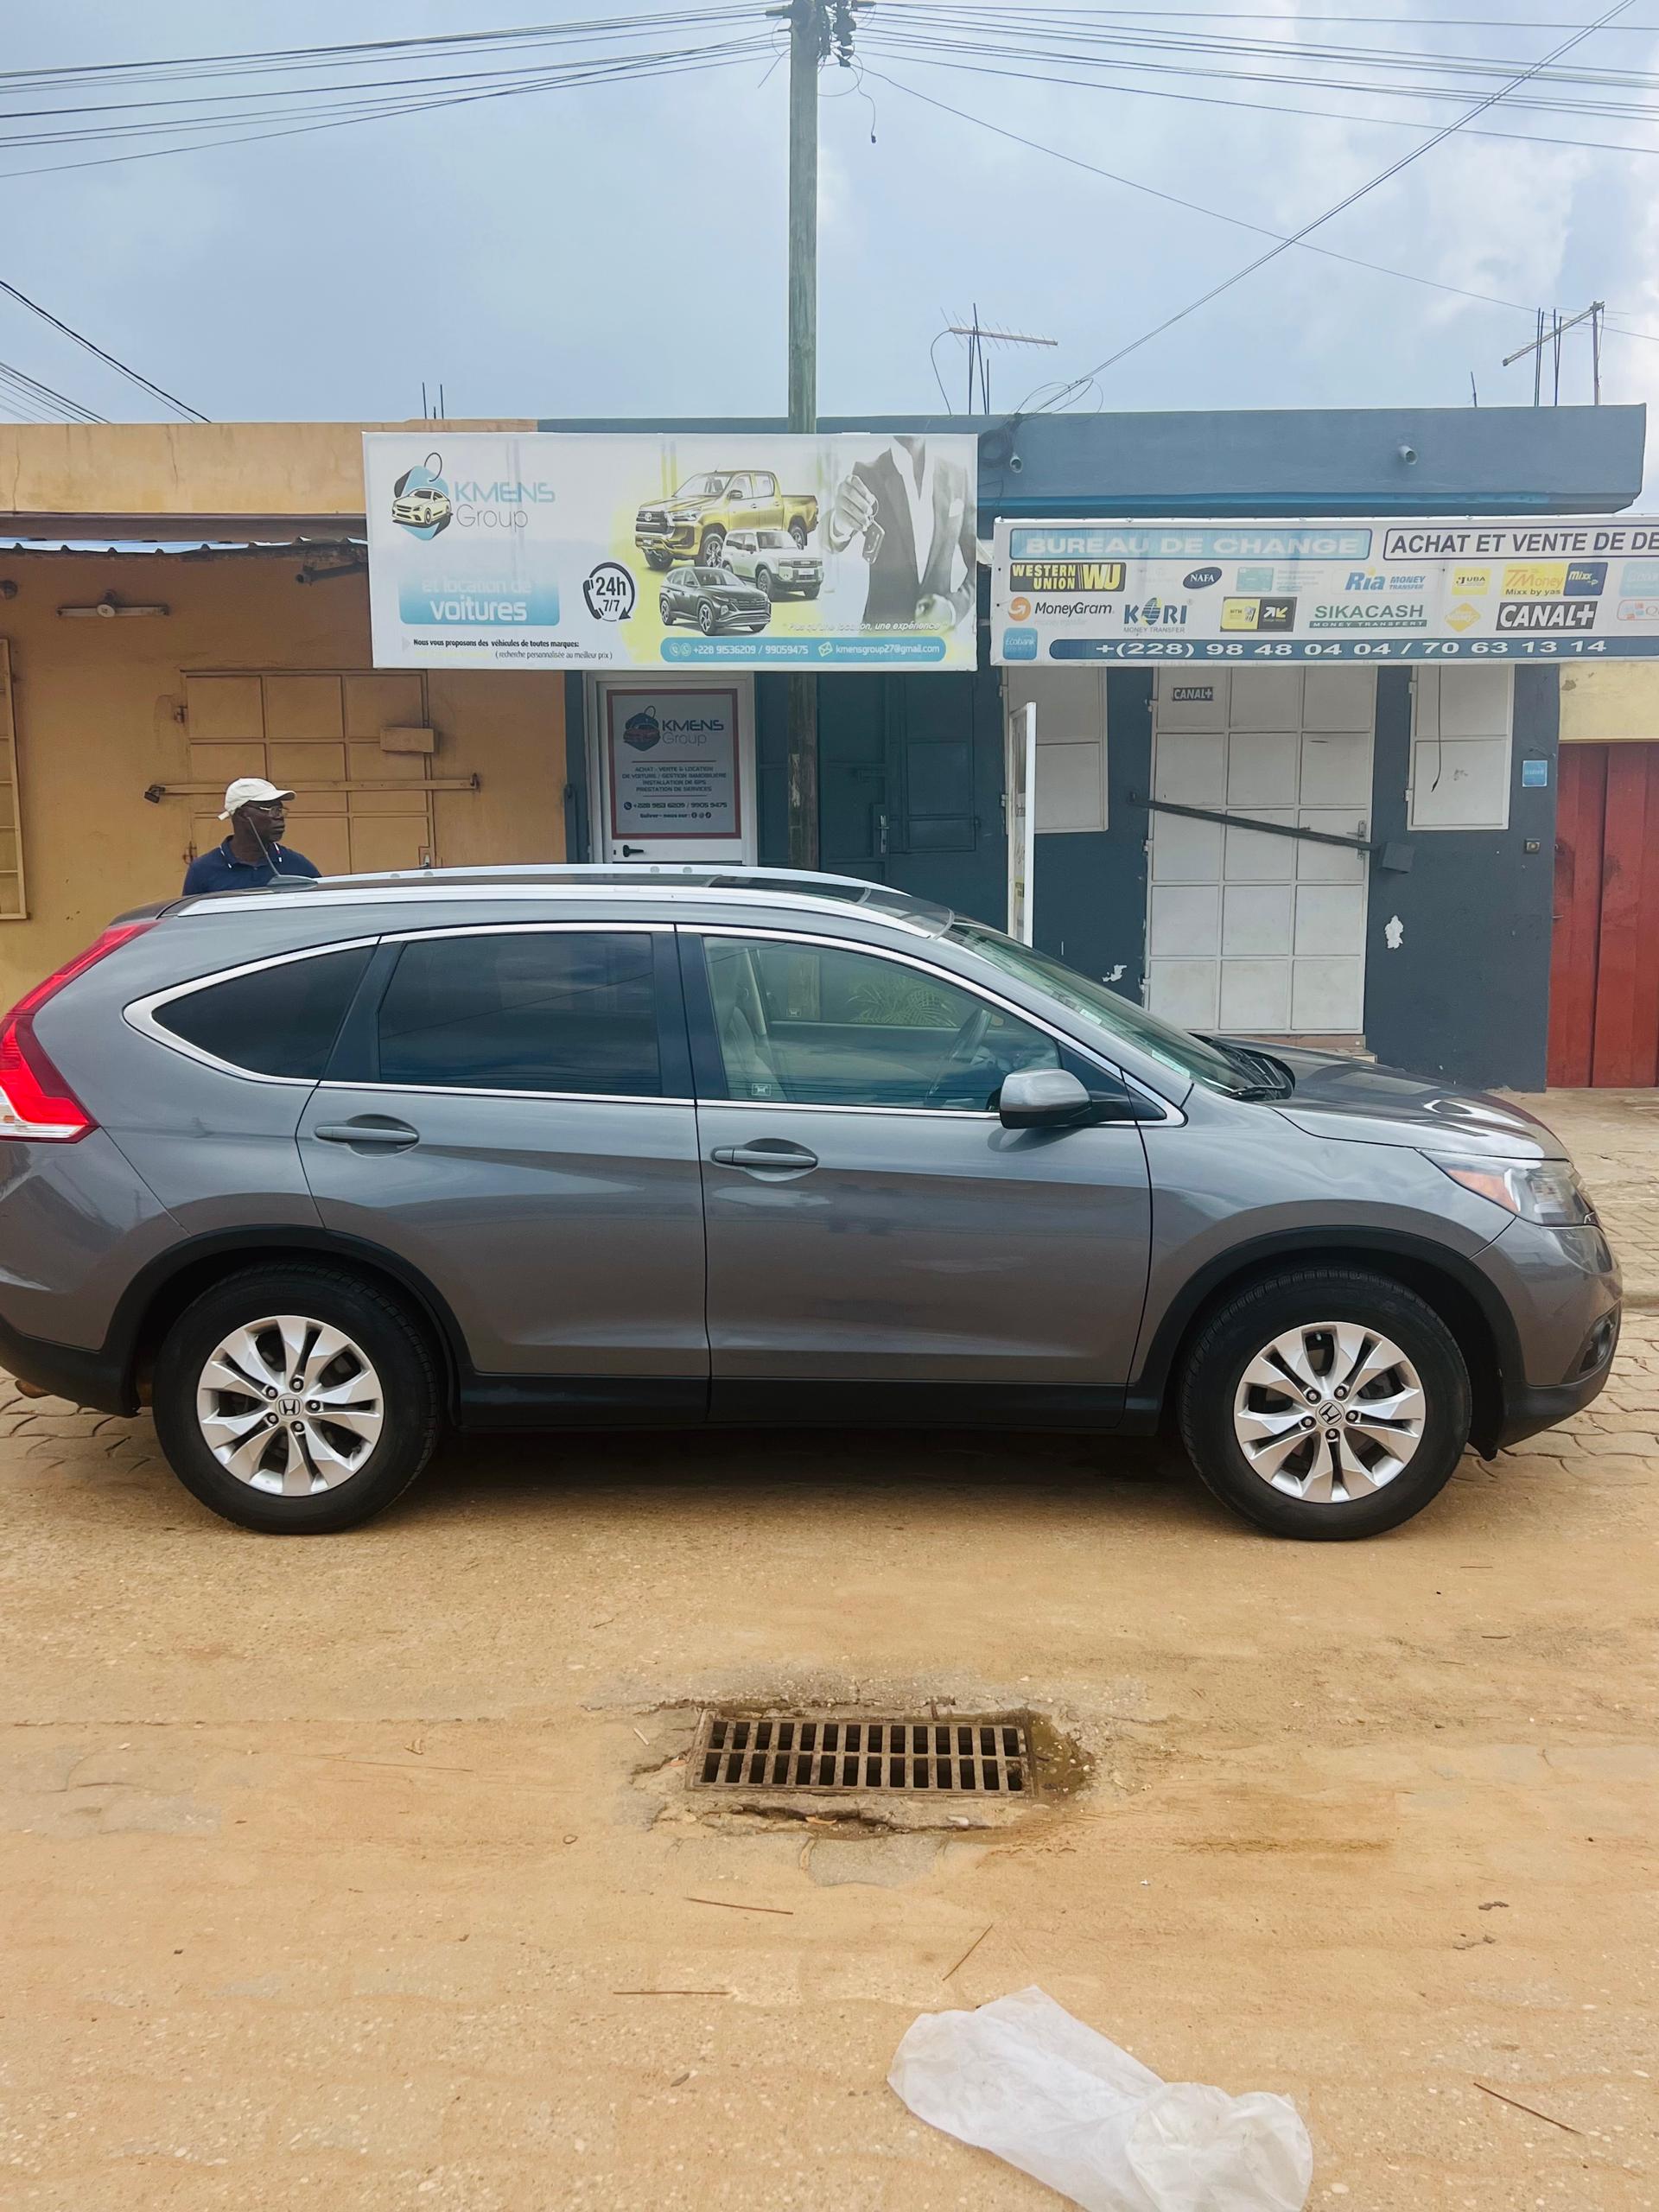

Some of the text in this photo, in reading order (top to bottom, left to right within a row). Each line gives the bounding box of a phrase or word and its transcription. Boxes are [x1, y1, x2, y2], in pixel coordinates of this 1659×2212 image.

[454, 481, 556, 503] KMENS
[456, 505, 528, 531] Group
[1026, 537, 1358, 555] BUREAU DE CHANGE
[1390, 534, 1470, 554] ACHAT
[1476, 534, 1505, 553] ET
[1512, 532, 1588, 552] VENTE
[1593, 532, 1626, 550] DE
[1012, 564, 1076, 576] WESTERN
[1083, 563, 1121, 590] WU
[1033, 577, 1075, 589] UNION
[1190, 573, 1215, 582] NAFA
[1344, 566, 1386, 590] Ria
[595, 576, 626, 596] 24h
[429, 594, 527, 621] voitures
[603, 600, 620, 613] 7/7
[1035, 602, 1112, 617] MoneyGram
[1315, 605, 1424, 619] SIKACASH
[1500, 604, 1594, 627] CANAL+
[893, 620, 940, 632] expérience
[446, 639, 476, 648] proposons
[550, 640, 580, 649] marques:
[693, 644, 939, 656] +228 91536209 / 99059475 kmensgroup27@gmail.com
[1096, 640, 1607, 658] +(228) 98 48 04 04 / 70 63 13 14
[1174, 688, 1212, 699] CANAL+
[662, 720, 724, 731] KMENS
[662, 732, 707, 747] Group
